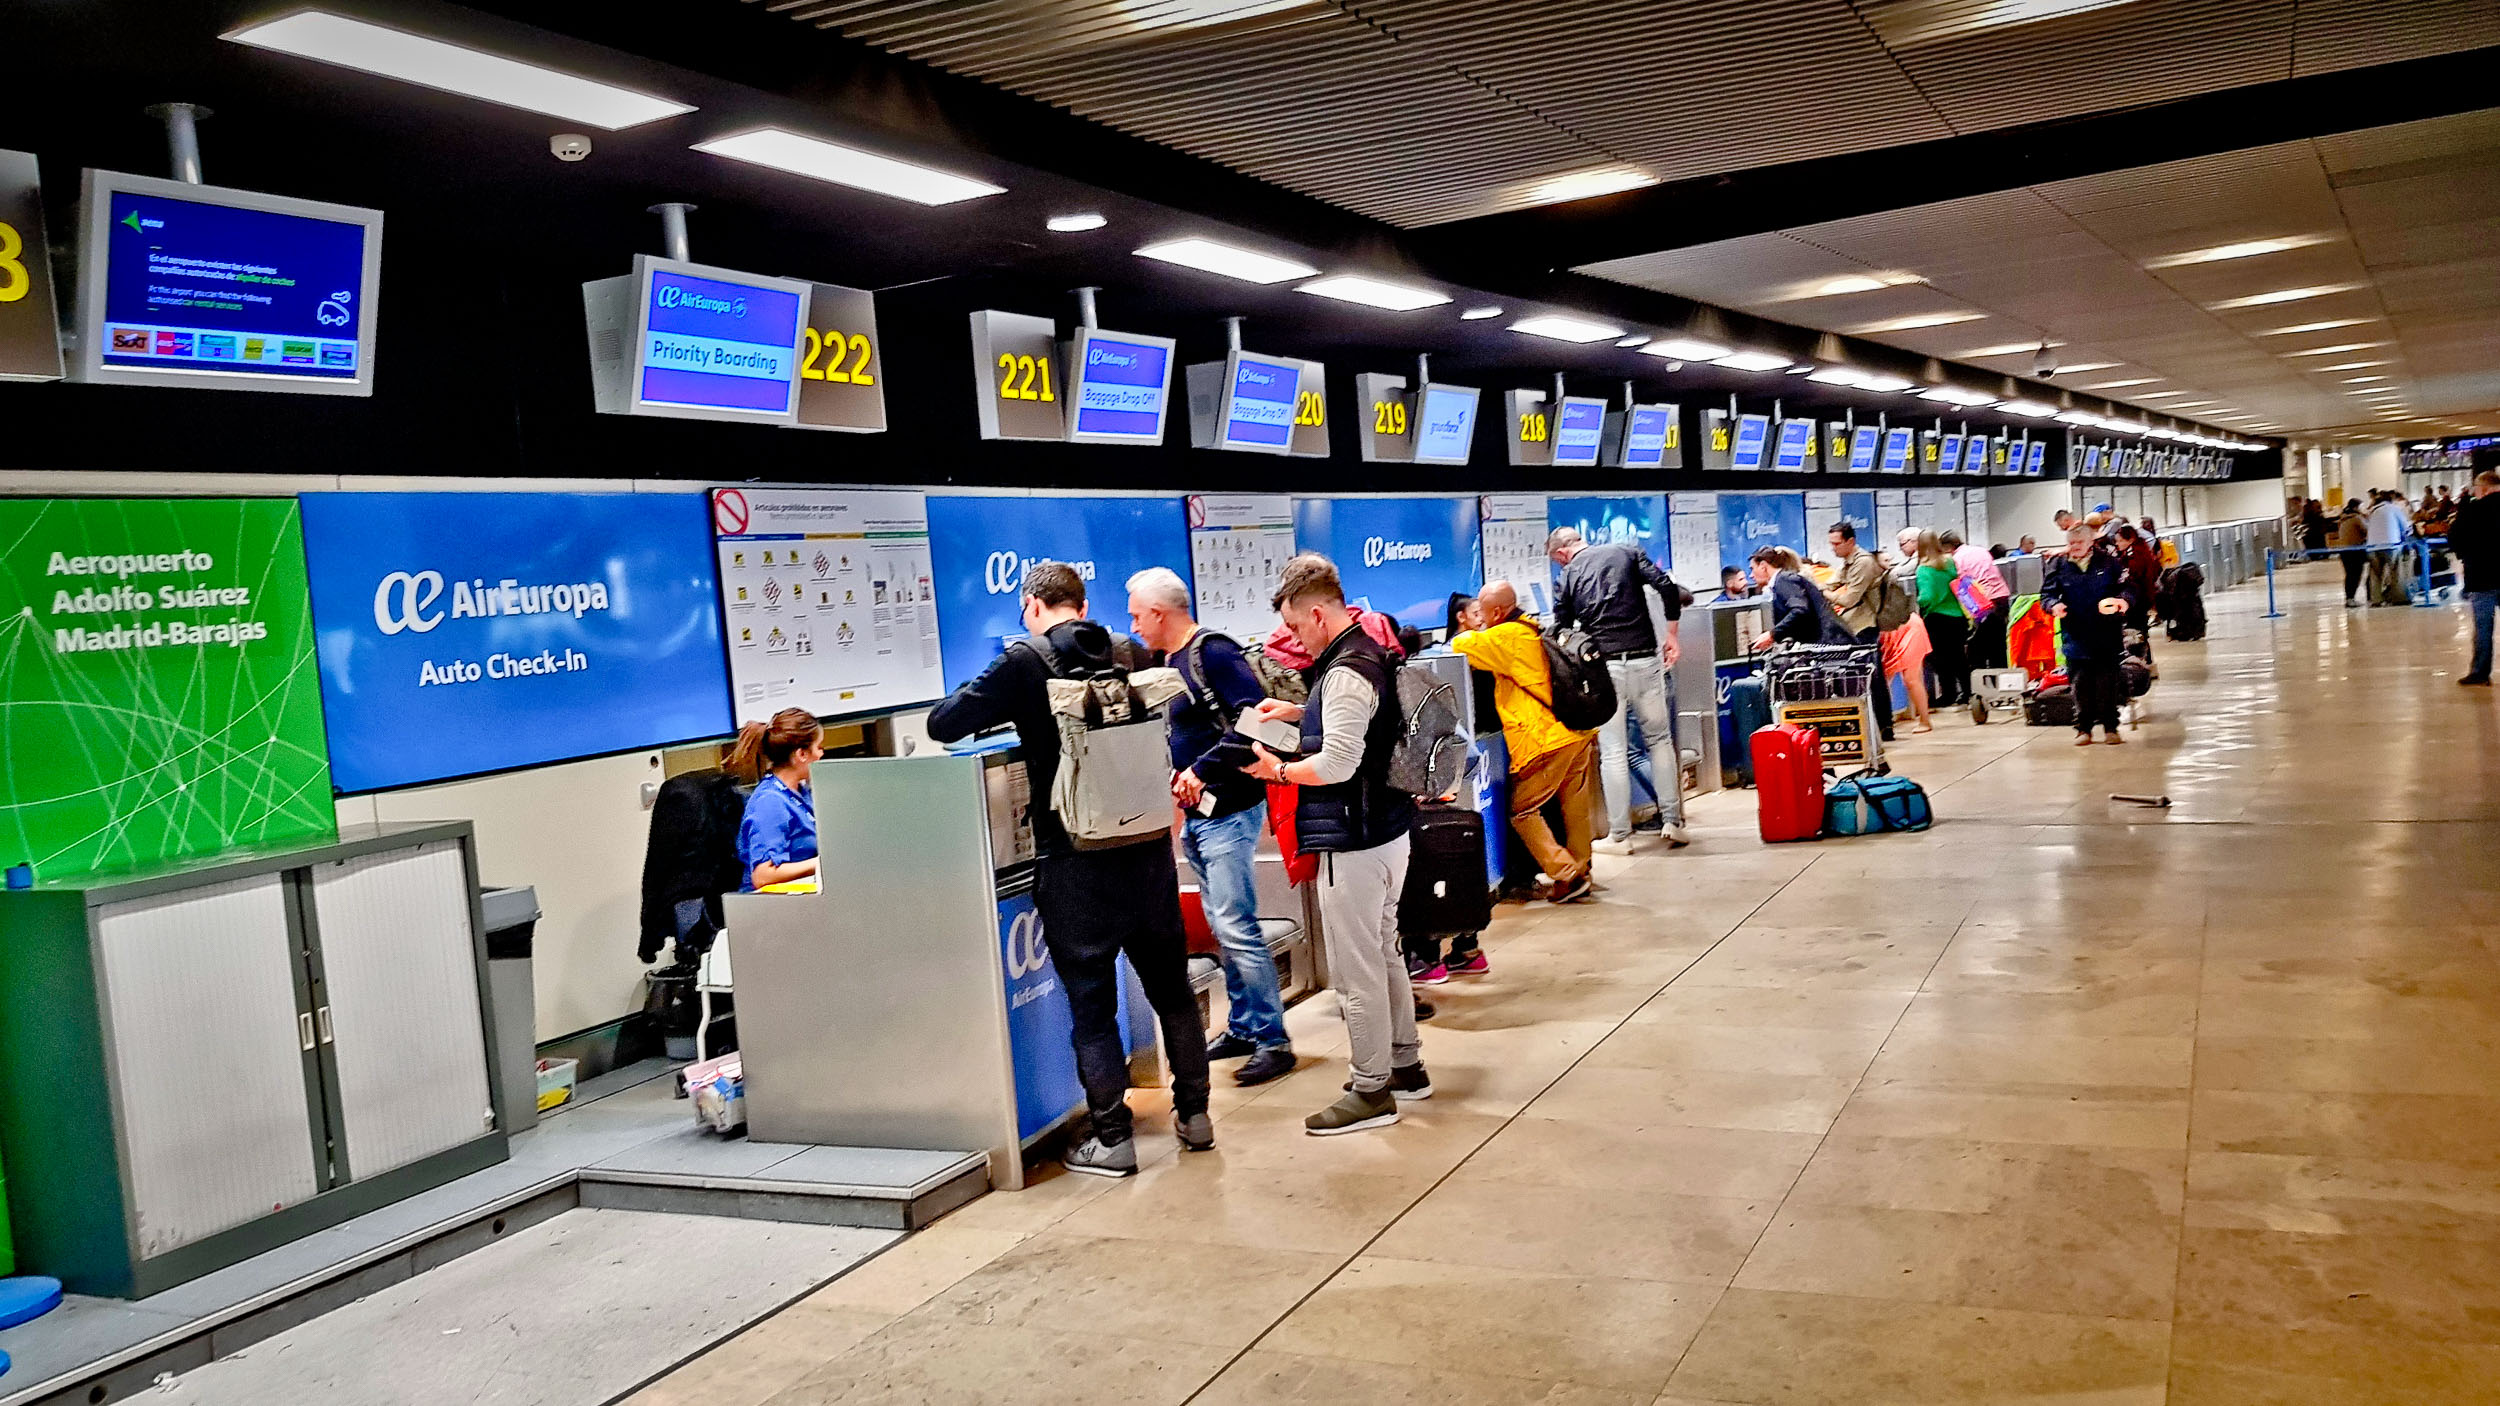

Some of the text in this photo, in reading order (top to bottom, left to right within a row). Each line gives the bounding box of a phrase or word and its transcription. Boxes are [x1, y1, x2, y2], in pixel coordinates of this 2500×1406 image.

[681, 294, 731, 315] AirEuropa
[653, 339, 778, 374] Priority Boarding
[802, 327, 874, 386] 222
[999, 353, 1055, 402] 221
[1121, 391, 1140, 407] Drop
[1294, 390, 1325, 427] 20
[1374, 401, 1407, 434] 219
[1520, 413, 1547, 442] 218
[46, 549, 213, 581] Aeropuerto
[1384, 540, 1432, 563] AirEuropa
[51, 583, 251, 614] Adolfo Suárez
[451, 578, 609, 619] AirEuropa
[54, 617, 267, 654] Madrid-Barajas
[419, 648, 588, 687] Auto Check-In
